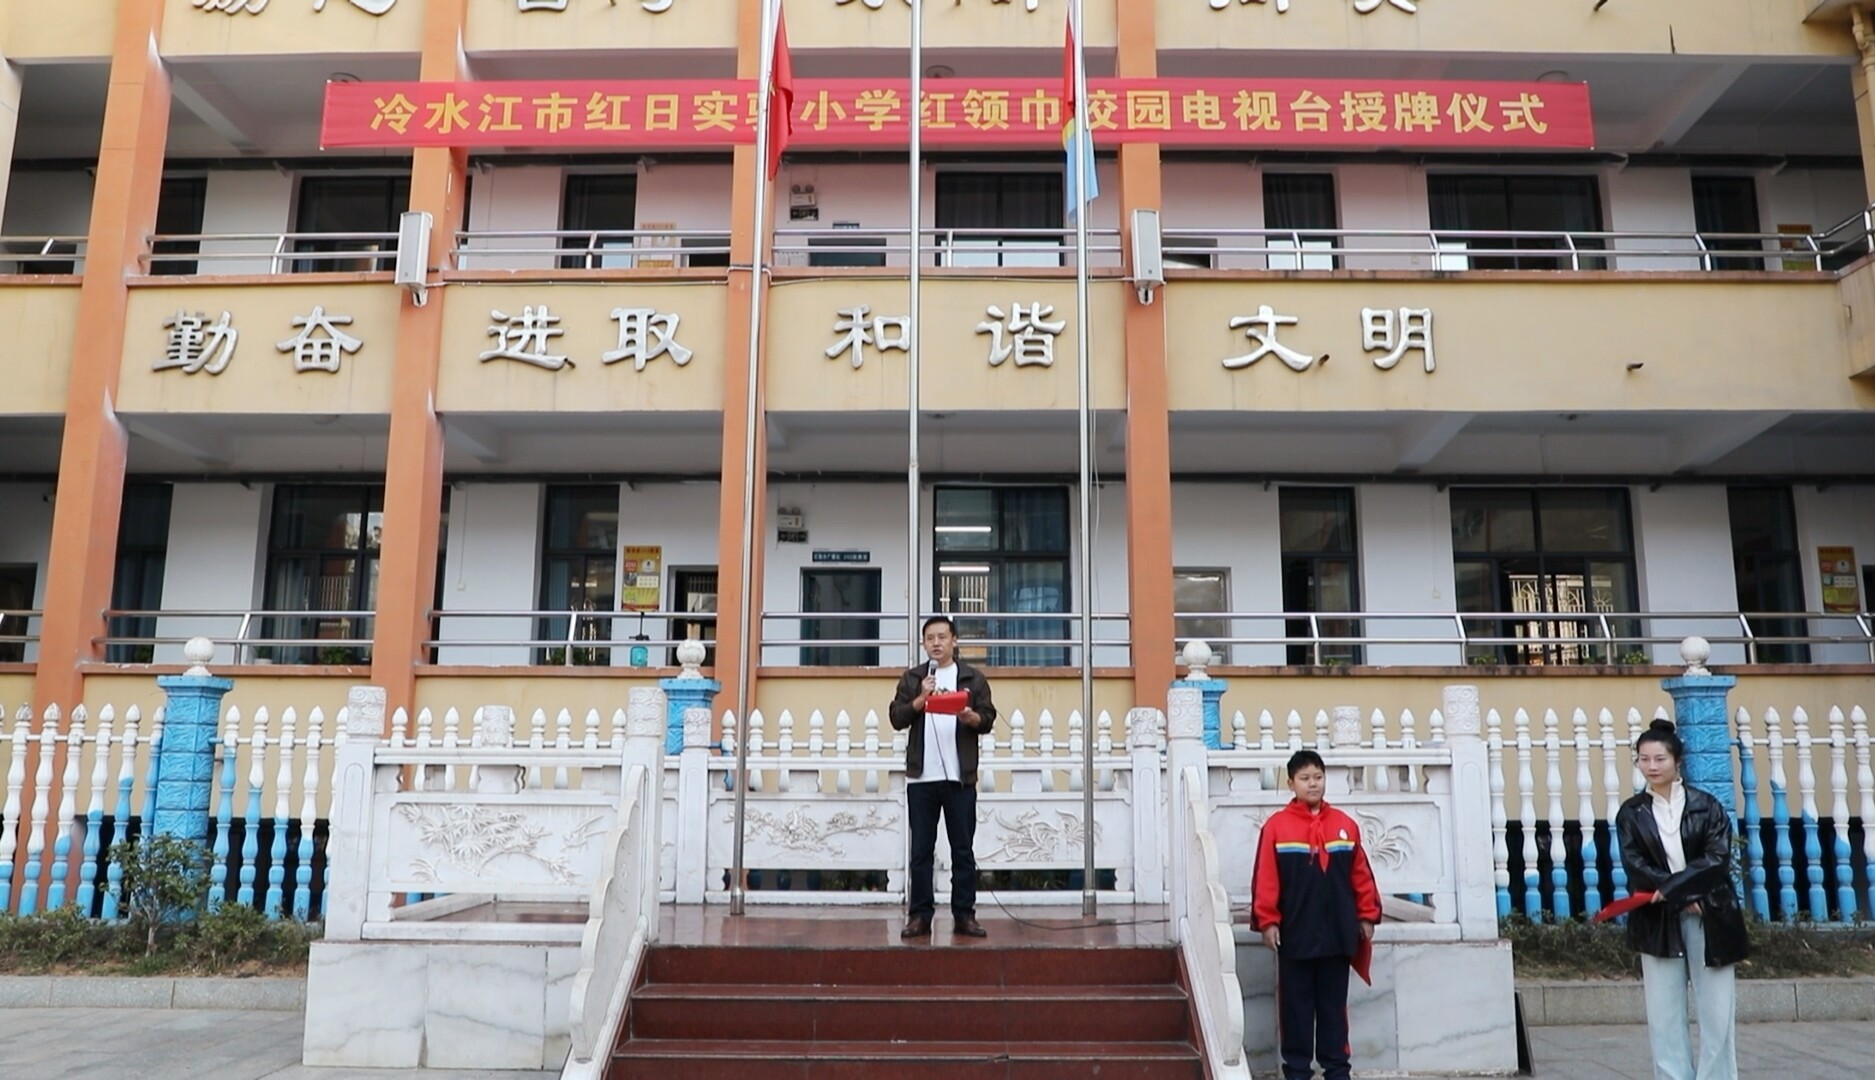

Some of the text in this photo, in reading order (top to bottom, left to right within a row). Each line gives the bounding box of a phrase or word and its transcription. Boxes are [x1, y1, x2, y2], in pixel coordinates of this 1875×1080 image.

[369, 89, 1549, 135] 冷水江市红日实小学红领巾校园电视台授牌仪式
